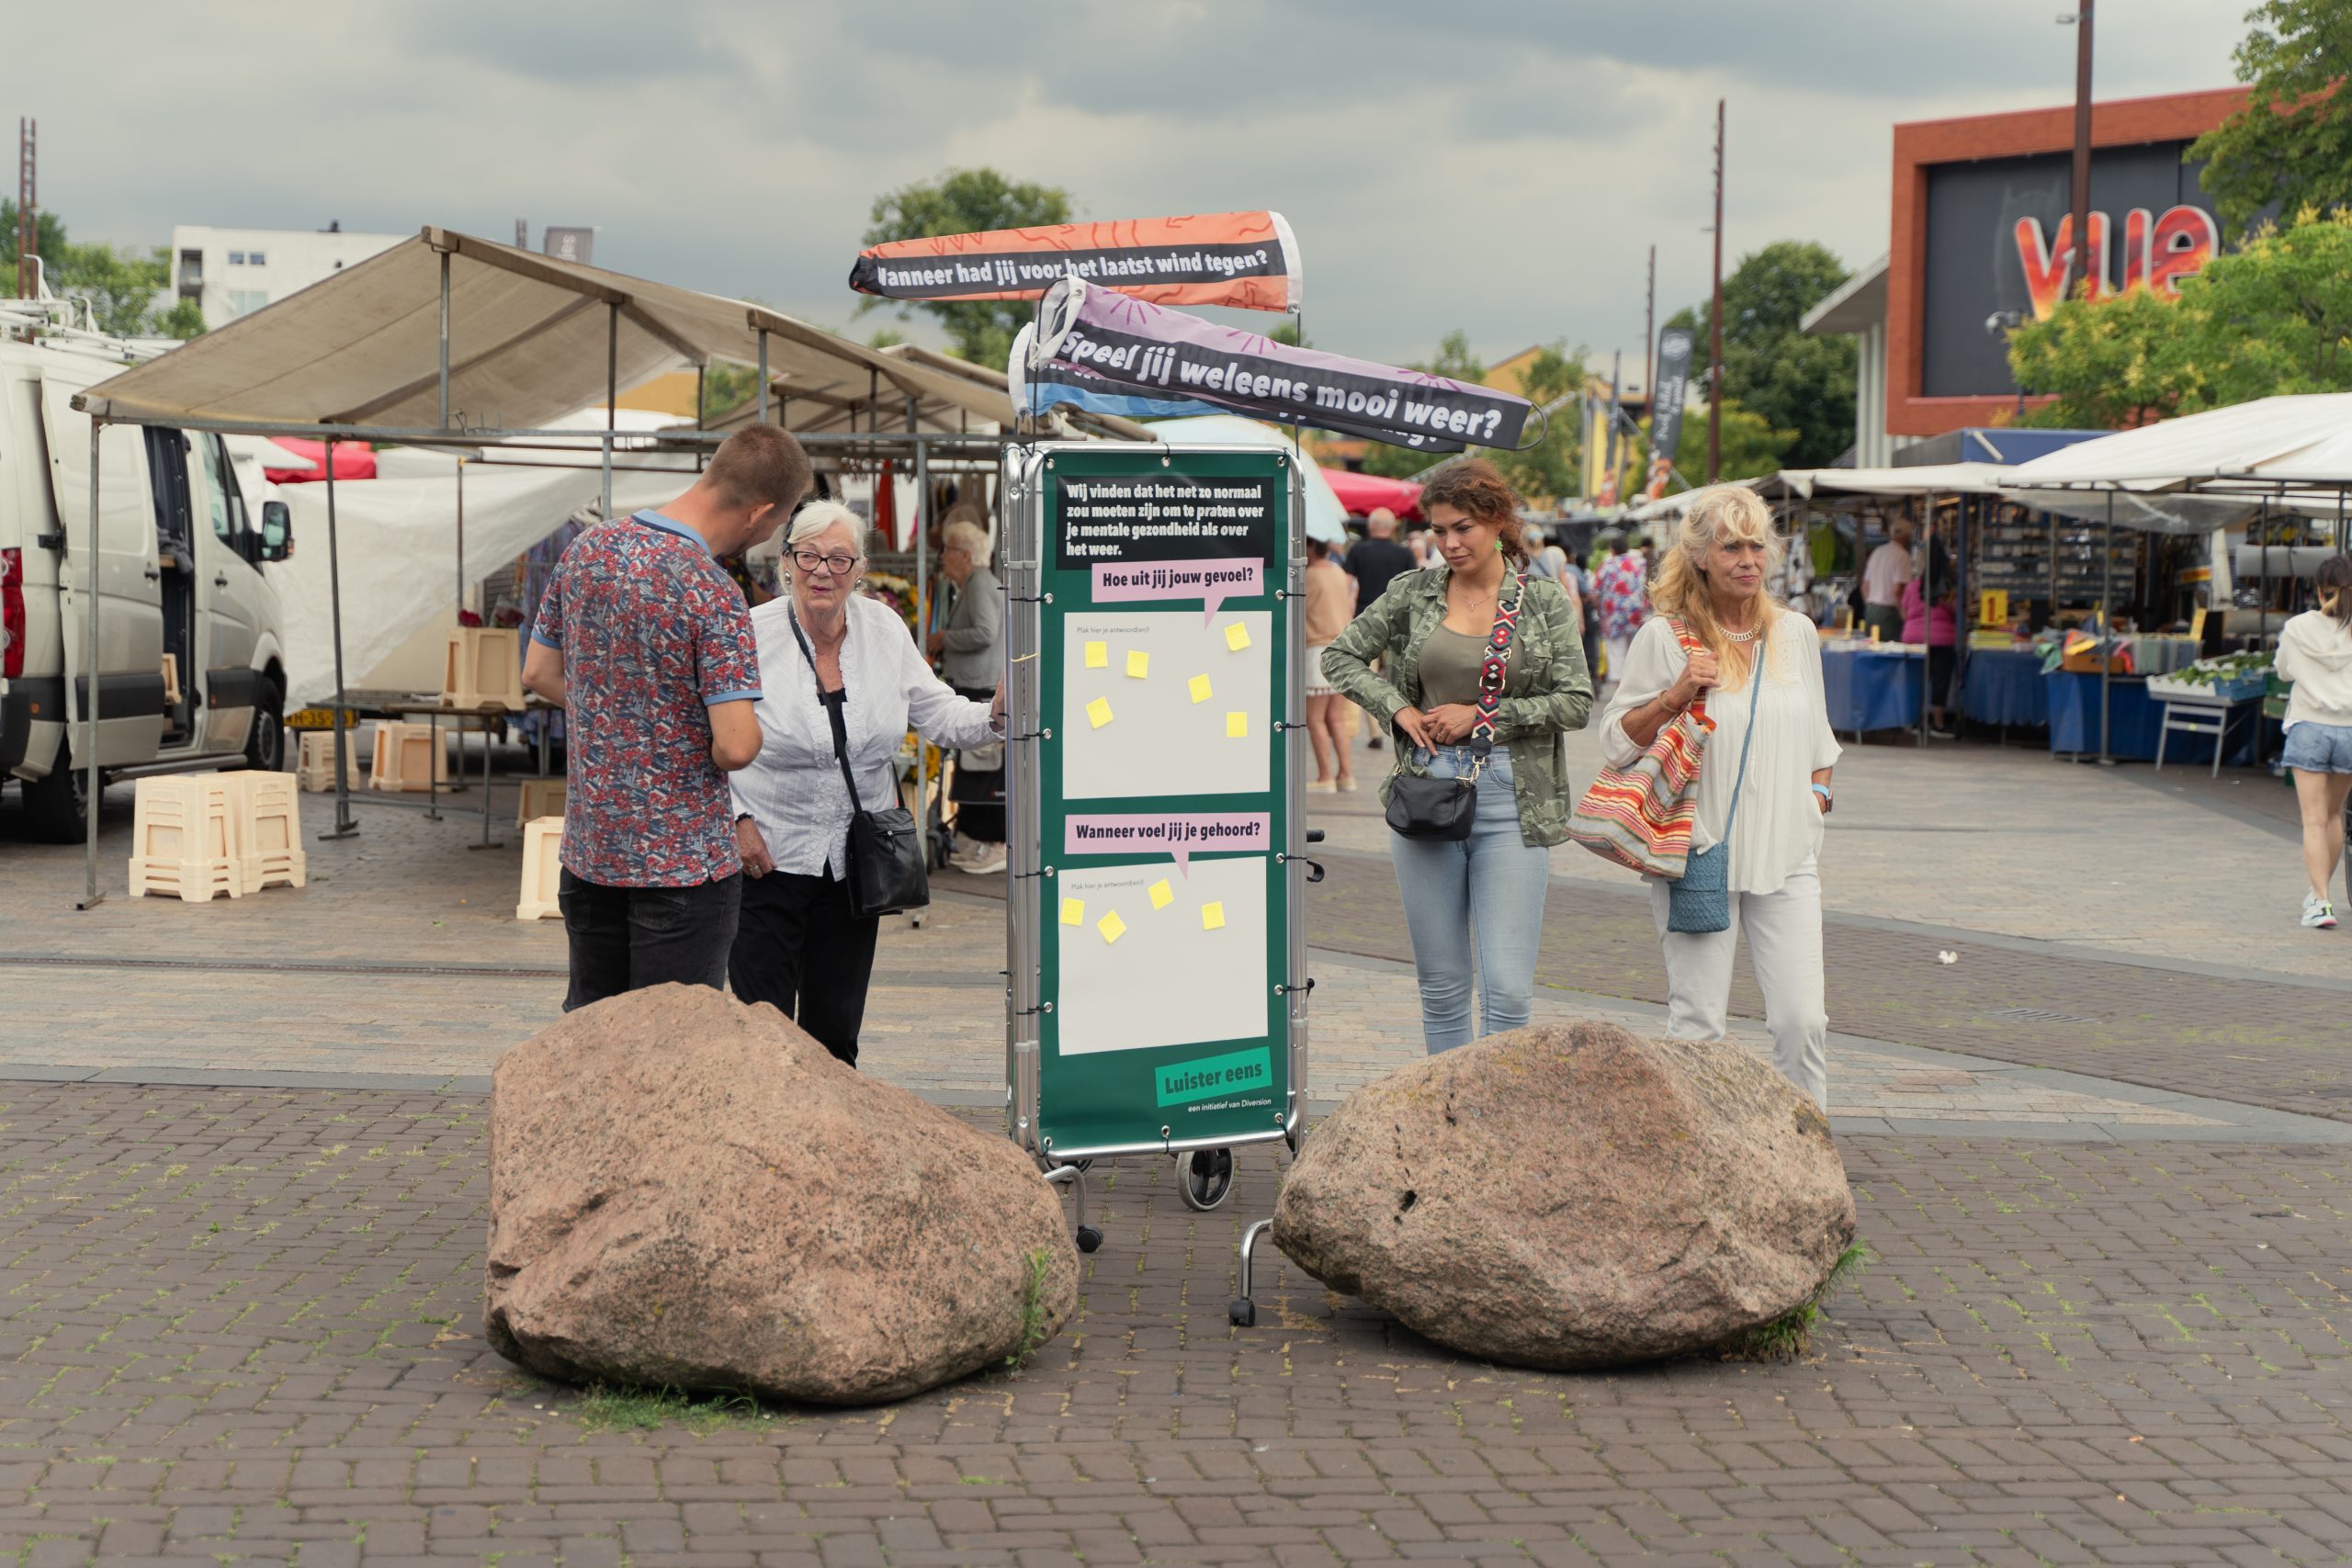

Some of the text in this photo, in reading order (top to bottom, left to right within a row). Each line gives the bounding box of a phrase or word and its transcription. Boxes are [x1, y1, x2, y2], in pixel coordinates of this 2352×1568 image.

[956, 261, 992, 283] had
[995, 260, 1018, 287] jij
[1020, 263, 1061, 279] voor
[1066, 259, 1098, 277] het
[1101, 256, 1154, 276] laatst
[1156, 252, 1202, 272] wind
[1204, 250, 1268, 276] tegen?
[1059, 331, 1141, 370] Speel
[1136, 347, 1176, 384] jij
[1181, 361, 1310, 402] weleens
[1316, 385, 1399, 419] mooi
[1404, 400, 1501, 439] weer?
[1067, 483, 1261, 502] Wij vinden dat het net zo normaal
[1067, 502, 1263, 521] zou moeten zijn om te praten over
[1066, 522, 1248, 540] je mentale gezondheid als over
[1066, 541, 1122, 556] het weer.
[1102, 567, 1253, 589] Hoe uit jij jouw gevoel?
[1076, 821, 1260, 841] Wanneer voel jij je gehoord?
[1165, 1064, 1262, 1094] Luister eens
[1202, 1101, 1227, 1111] initiatief
[1241, 1099, 1272, 1108] Diversion
